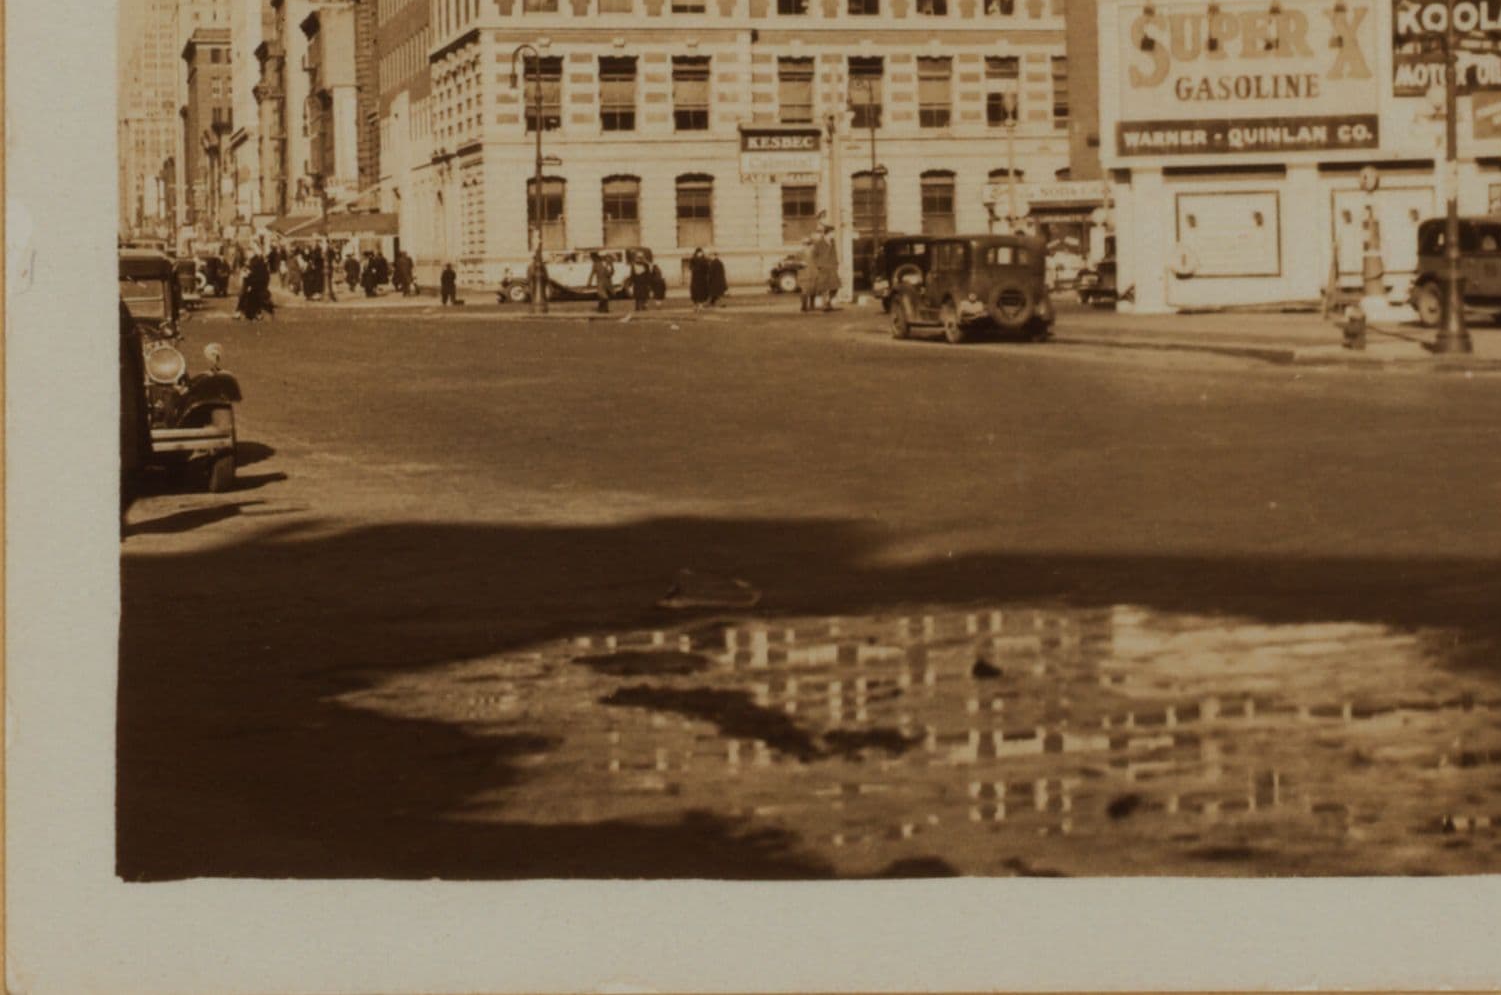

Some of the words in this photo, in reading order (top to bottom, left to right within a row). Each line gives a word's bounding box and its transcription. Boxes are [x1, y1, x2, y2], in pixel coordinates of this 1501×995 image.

[1128, 8, 1316, 89] SUPER
[1323, 5, 1374, 81] X
[1174, 73, 1321, 102] GASOLINE
[747, 136, 815, 150] KESBEC
[1124, 130, 1208, 148] WARNER
[1226, 126, 1327, 148] QUINLAN
[1337, 124, 1374, 143] CO.
